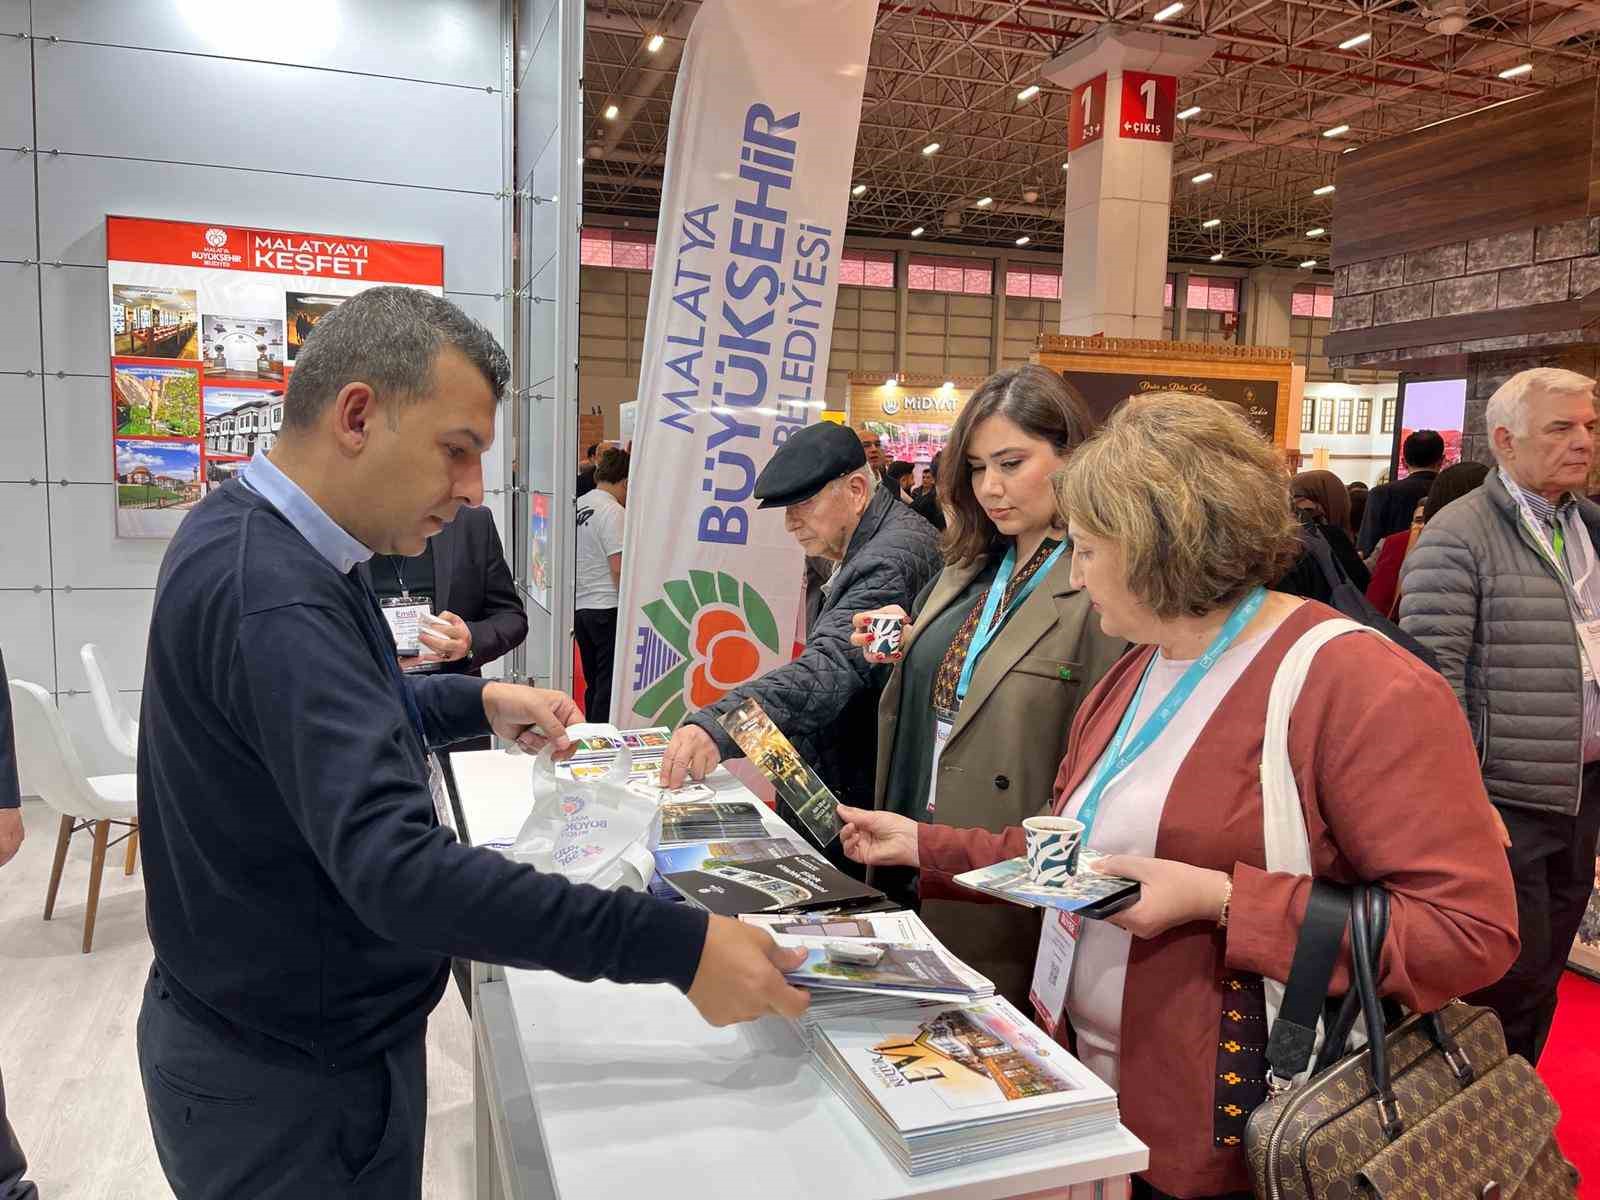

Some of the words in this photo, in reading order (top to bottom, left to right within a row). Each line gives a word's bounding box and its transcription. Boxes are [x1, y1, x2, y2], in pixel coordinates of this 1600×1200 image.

[1081, 85, 1092, 126] 1
[1140, 79, 1156, 119] 1
[1133, 122, 1161, 135] ÇIKIŞ
[255, 235, 368, 257] MALATYA'YI
[255, 250, 368, 275] KEŞFET
[660, 204, 719, 435] MALATYA
[697, 103, 800, 545] BÜYÜKŞEHİR
